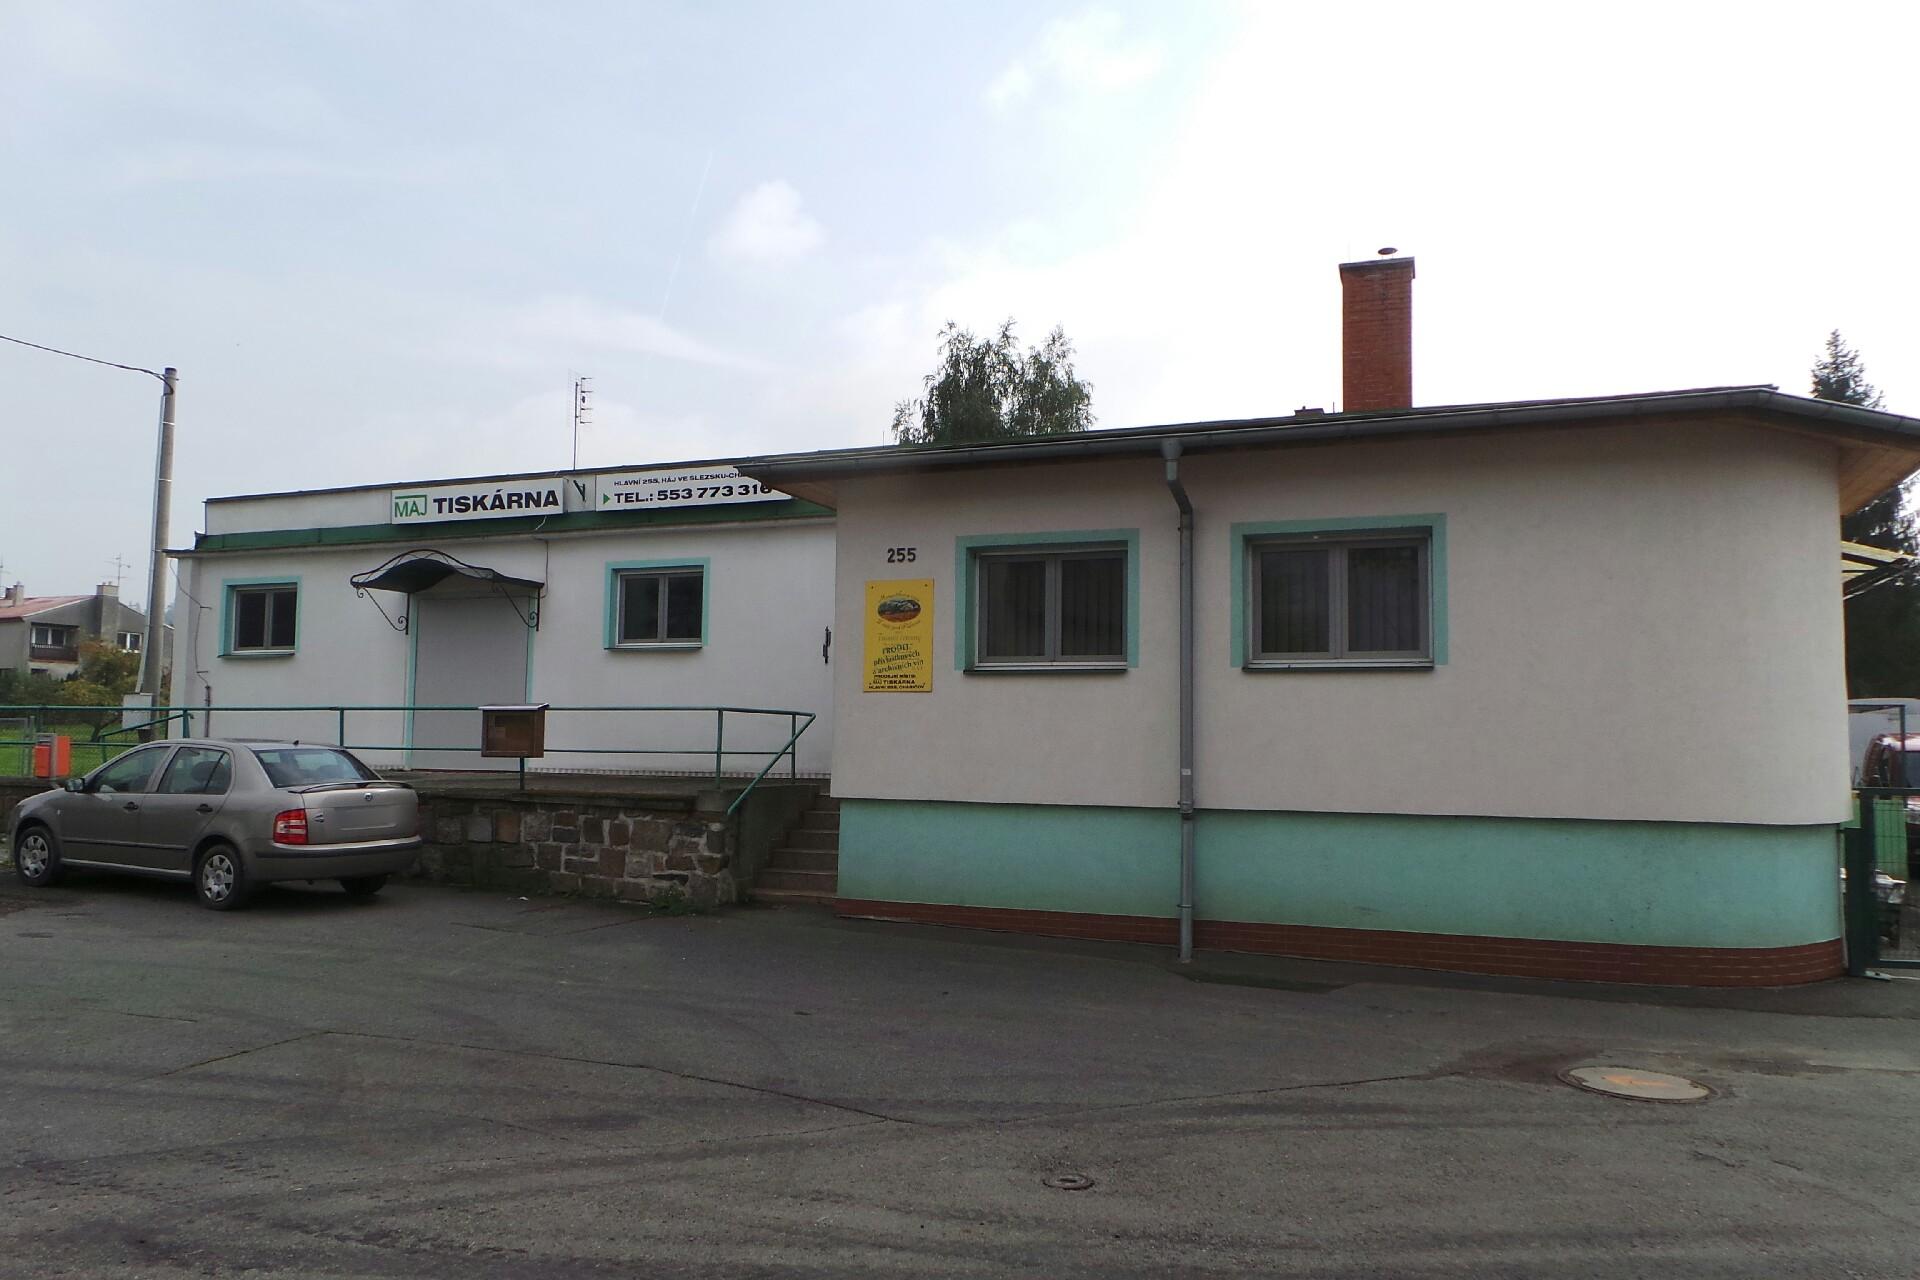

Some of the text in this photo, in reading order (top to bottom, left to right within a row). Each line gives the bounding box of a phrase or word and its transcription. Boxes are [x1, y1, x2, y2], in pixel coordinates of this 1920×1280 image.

[614, 478, 641, 487] HLAVNÍ
[661, 475, 677, 484] HÁJ
[689, 471, 744, 481] SLEZSKU-CH
[394, 488, 559, 518] MAJ TISKÁRNA
[614, 492, 654, 504] TEL.:
[657, 487, 693, 502] 553
[697, 485, 735, 499] 773
[887, 547, 917, 563] 255
